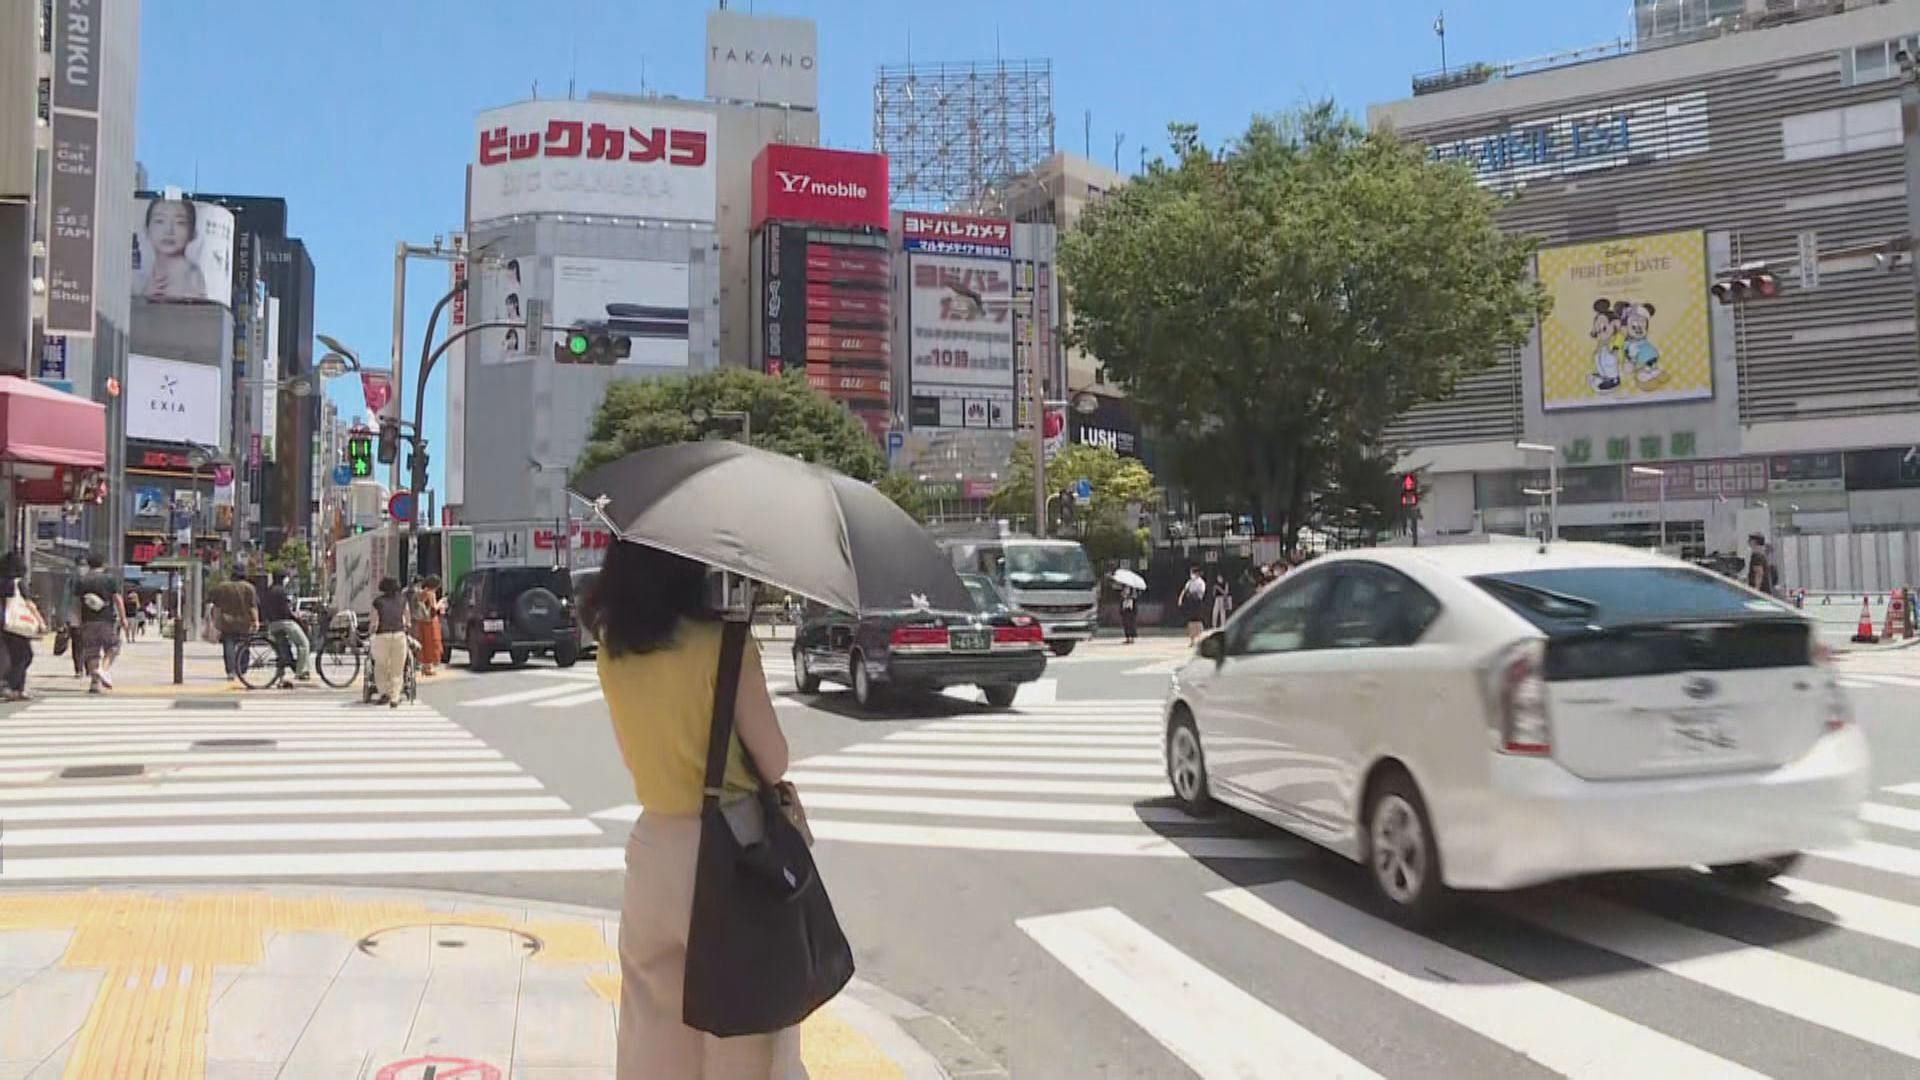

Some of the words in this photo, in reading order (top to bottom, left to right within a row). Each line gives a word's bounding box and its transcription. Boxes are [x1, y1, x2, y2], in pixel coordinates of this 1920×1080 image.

[711, 46, 813, 70] TAKANO
[479, 120, 707, 166] ビックカメラ
[905, 217, 1007, 240] ヨドバシカメラ
[1634, 256, 1672, 273] DATE
[150, 399, 185, 413] EXIA
[1080, 426, 1117, 450] LUSH
